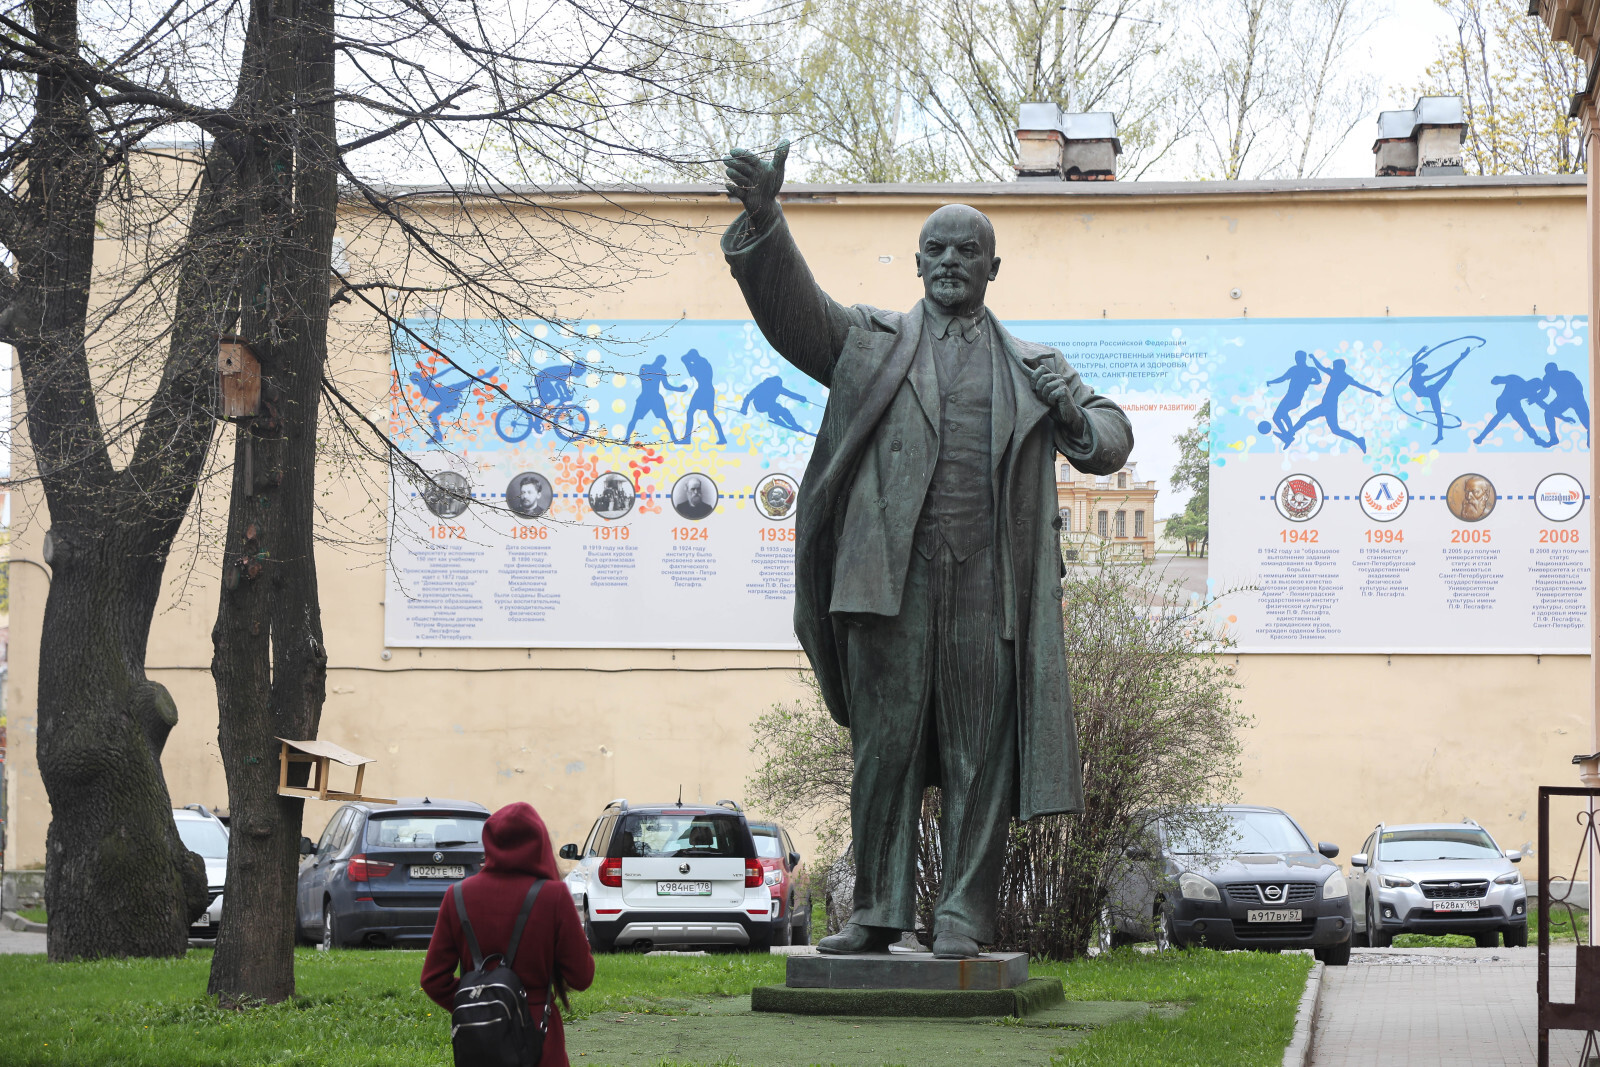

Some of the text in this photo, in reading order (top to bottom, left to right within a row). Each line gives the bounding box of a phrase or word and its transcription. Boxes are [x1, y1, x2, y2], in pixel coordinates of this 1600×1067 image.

[1072, 339, 1098, 347] спорта
[1099, 339, 1143, 347] Российской
[1144, 339, 1186, 347] Федерации
[1080, 352, 1156, 360] ГОСУДАРСТВЕННЫЙ
[1155, 352, 1208, 360] УНИВЕРСИТЕТ
[1159, 404, 1196, 412] РАЗВИТИЮ!
[429, 525, 466, 540] 1872
[511, 525, 548, 540] 1896
[593, 526, 630, 541] 1919
[671, 527, 709, 541] 1924
[759, 527, 796, 542] 1935
[1280, 529, 1319, 544] 1942
[1365, 529, 1404, 544] 1994
[1451, 528, 1492, 544] 2005
[1539, 528, 1580, 544] 2008
[660, 882, 694, 892] Х984НЕ
[1252, 912, 1287, 920] А917ВУ
